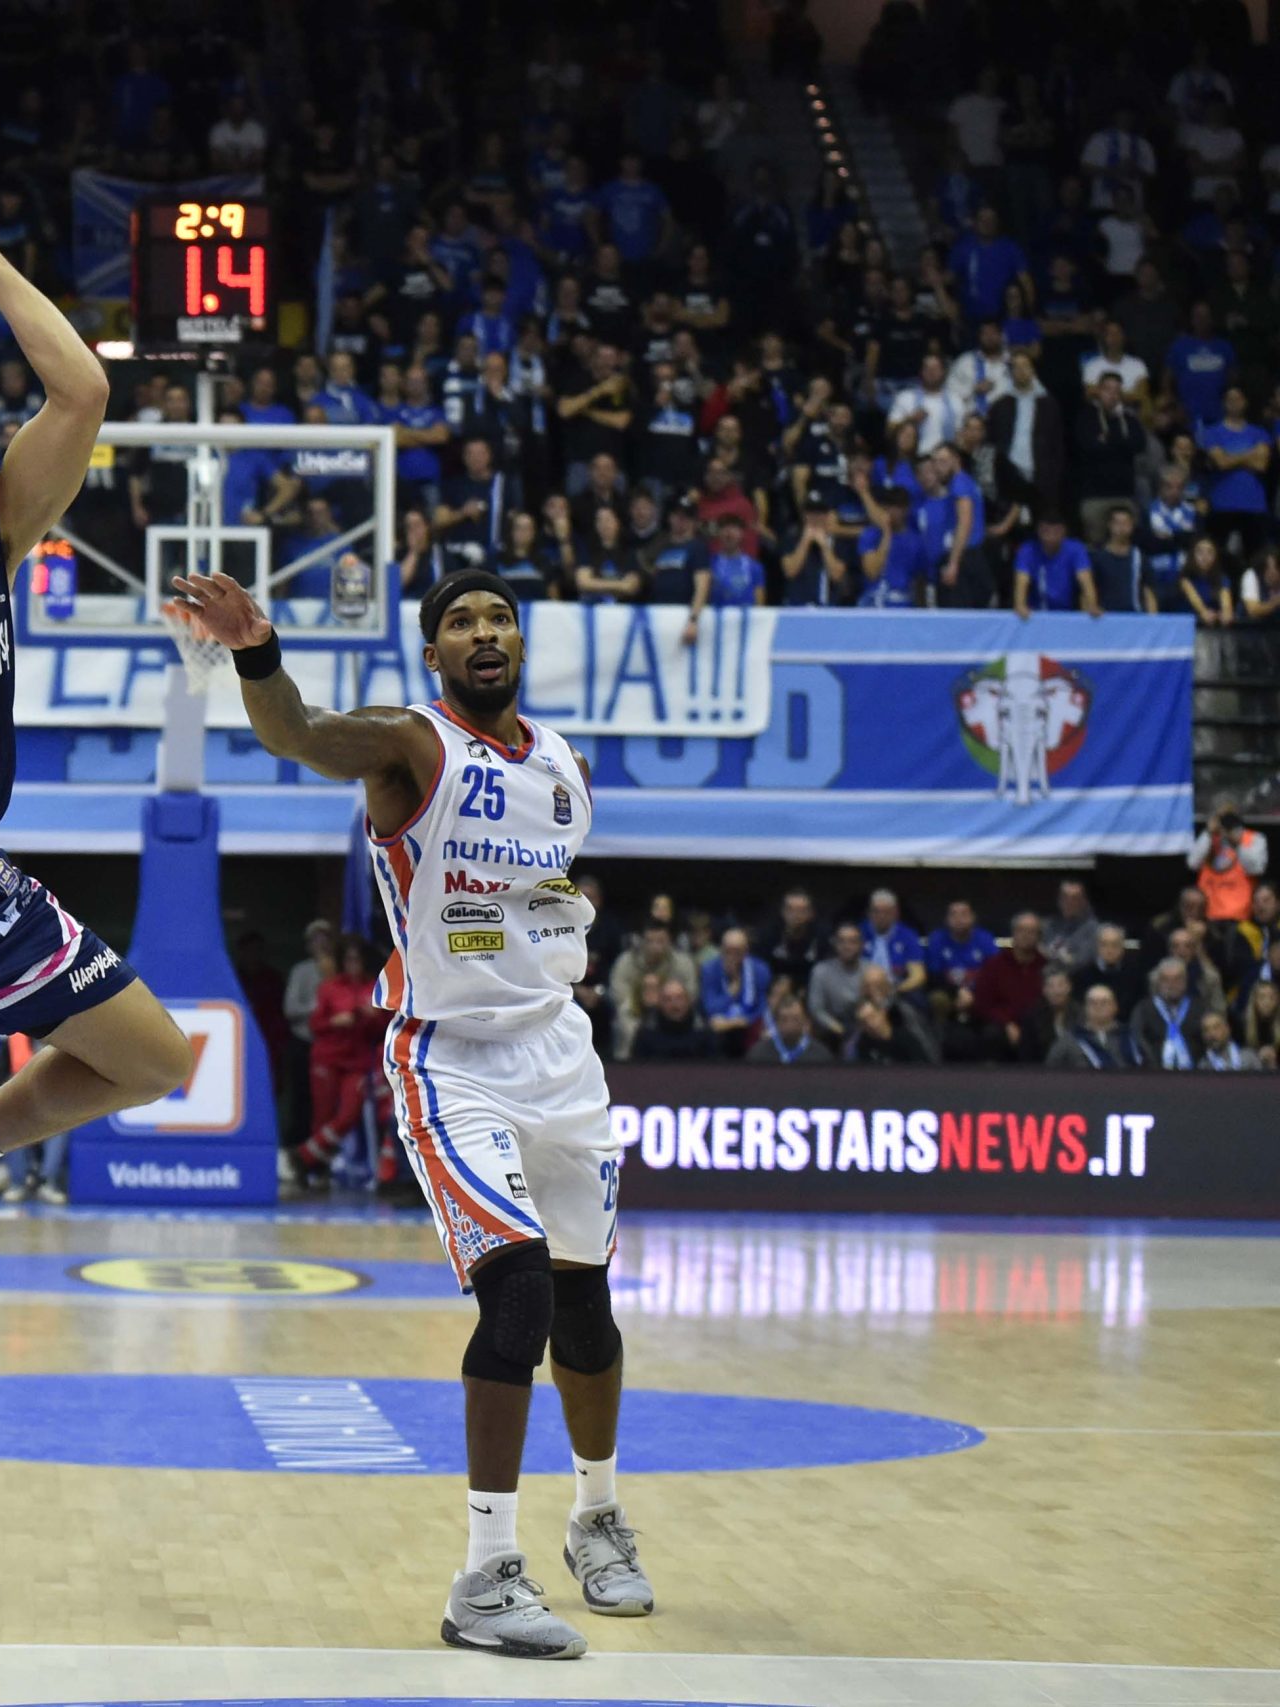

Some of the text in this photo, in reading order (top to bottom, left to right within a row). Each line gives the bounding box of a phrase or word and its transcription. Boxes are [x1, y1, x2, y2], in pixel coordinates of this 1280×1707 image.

[186, 246, 265, 316] 1.4
[459, 764, 505, 821] 25
[454, 935, 497, 949] CLIPPER
[609, 1105, 1155, 1177] POKERSTARSNEWS.IT
[107, 1161, 241, 1188] Volksbank
